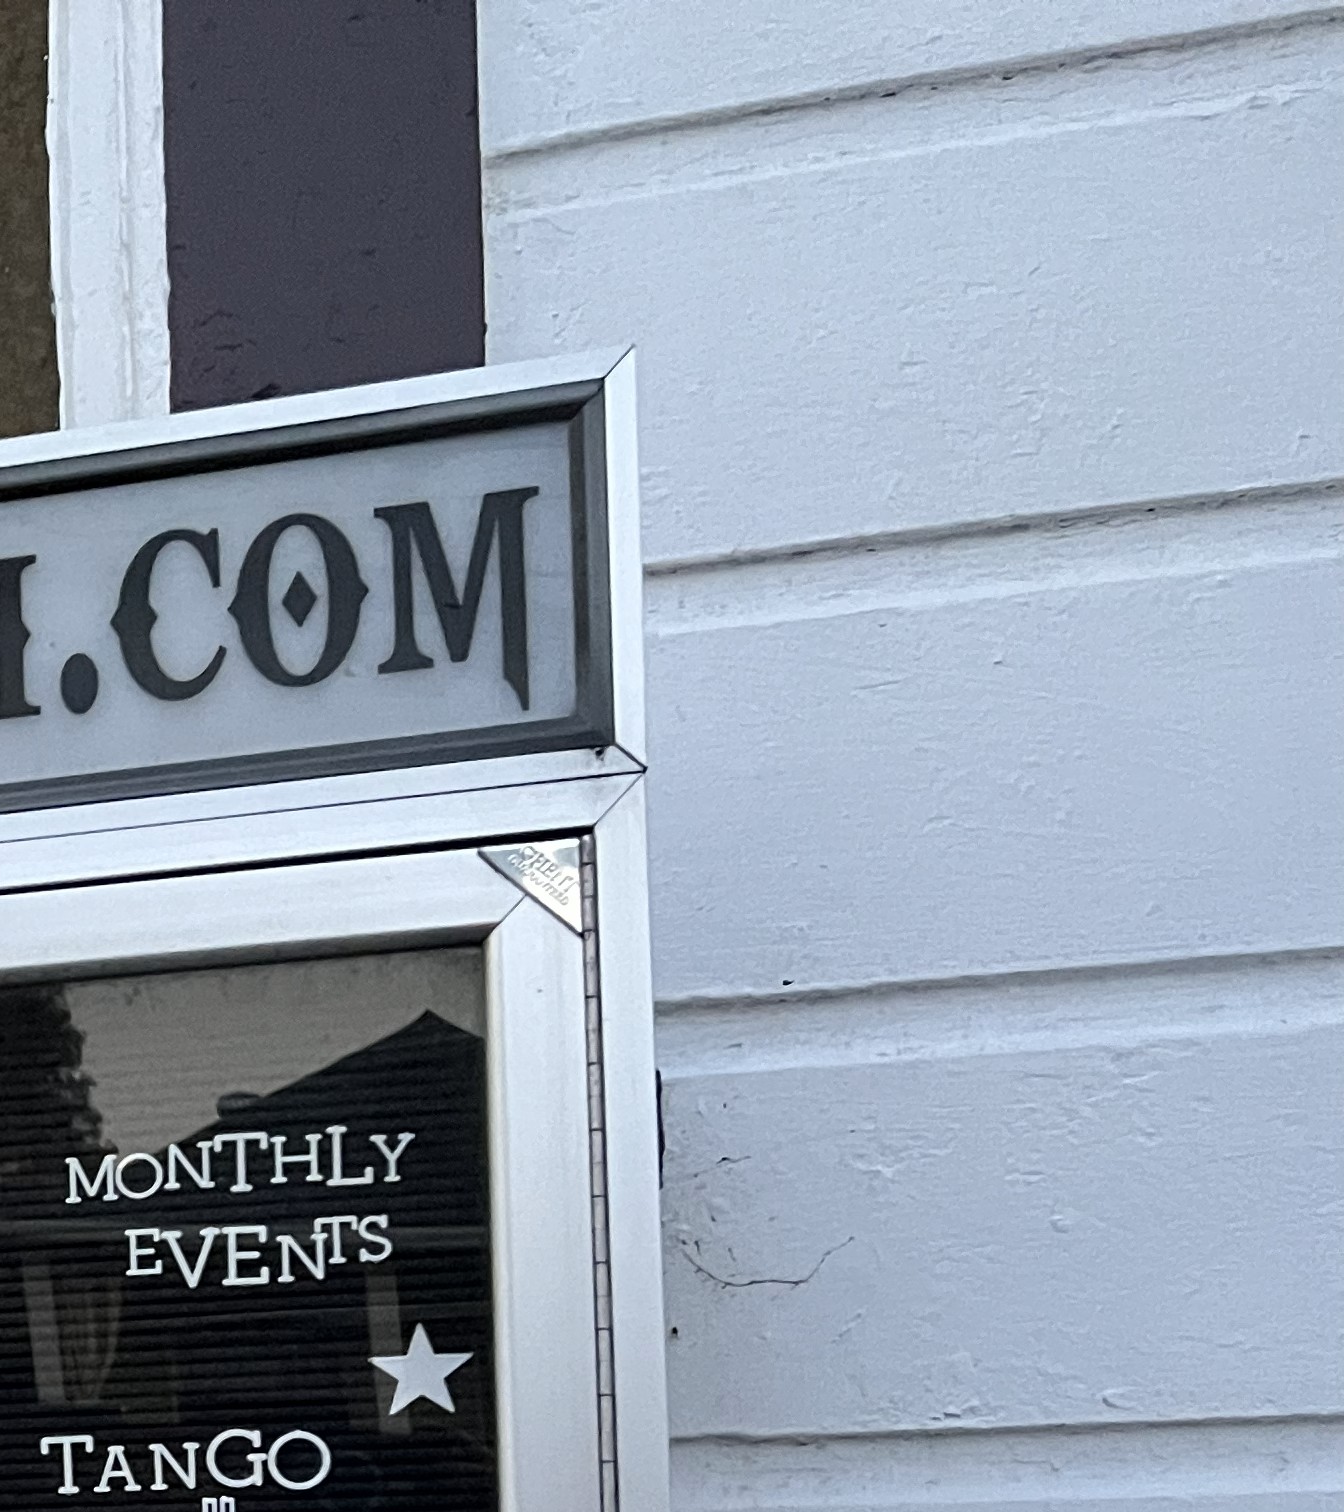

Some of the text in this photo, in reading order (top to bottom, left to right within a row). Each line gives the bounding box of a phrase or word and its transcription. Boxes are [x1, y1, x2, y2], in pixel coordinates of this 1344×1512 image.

[64, 1124, 416, 1204] MONTHLY
[124, 1214, 394, 1288] EVENTS
[40, 1428, 332, 1496] TANGO
